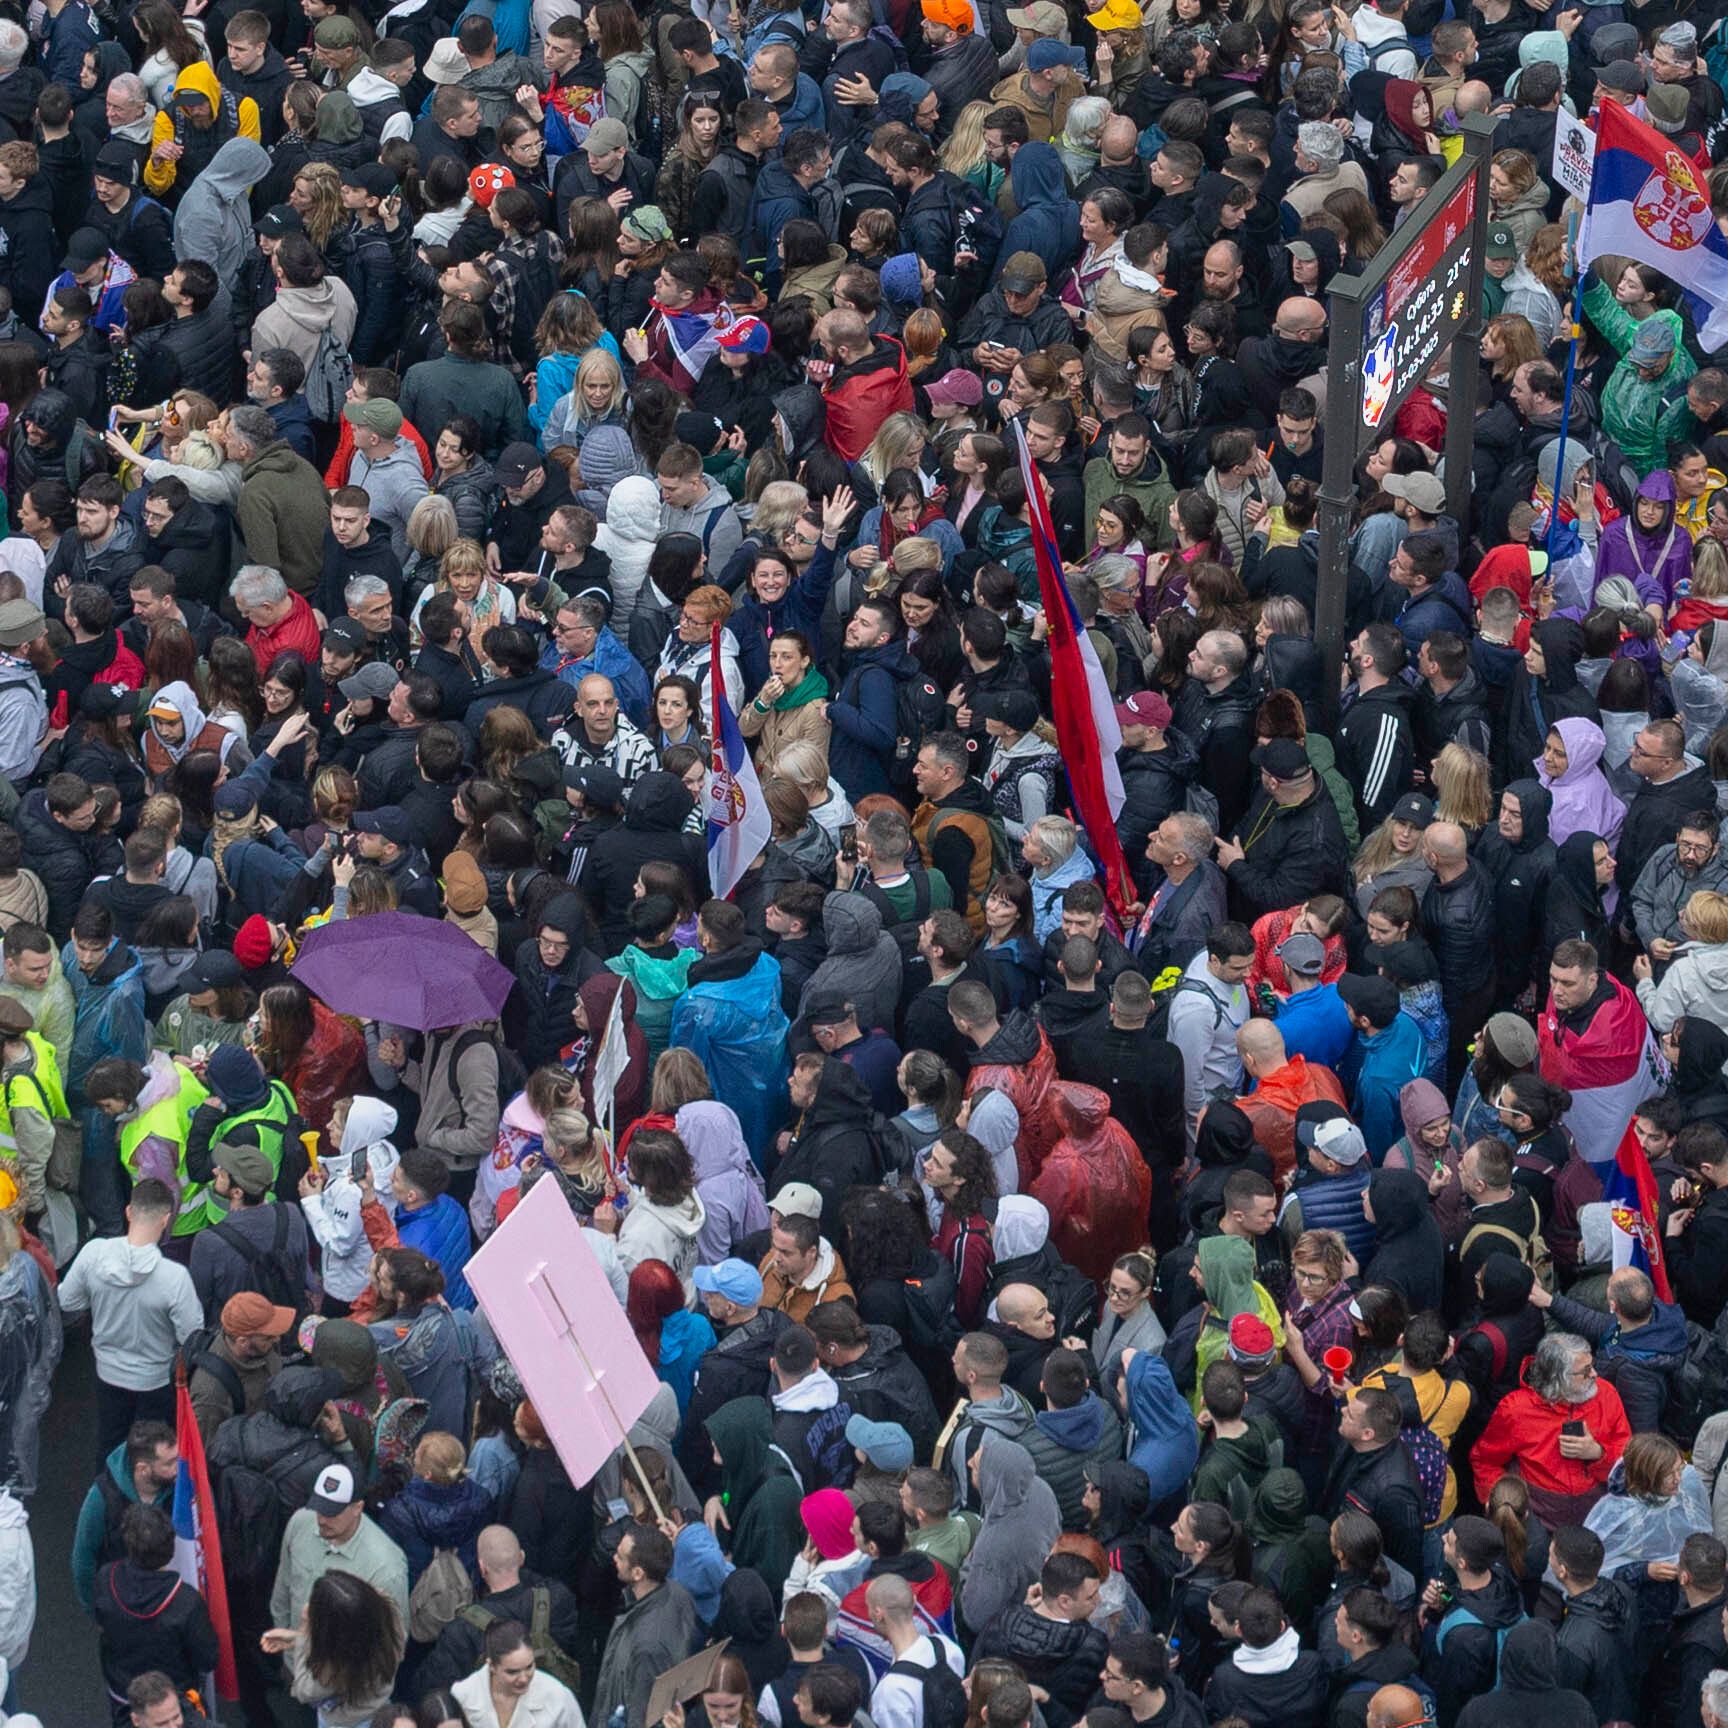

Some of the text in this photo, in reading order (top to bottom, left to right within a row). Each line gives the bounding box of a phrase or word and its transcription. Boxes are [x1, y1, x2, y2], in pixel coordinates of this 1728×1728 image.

[1563, 167, 1583, 188] MIRA
[1397, 293, 1443, 366] 14:14:35
[1397, 331, 1438, 393] 15-03-2025
